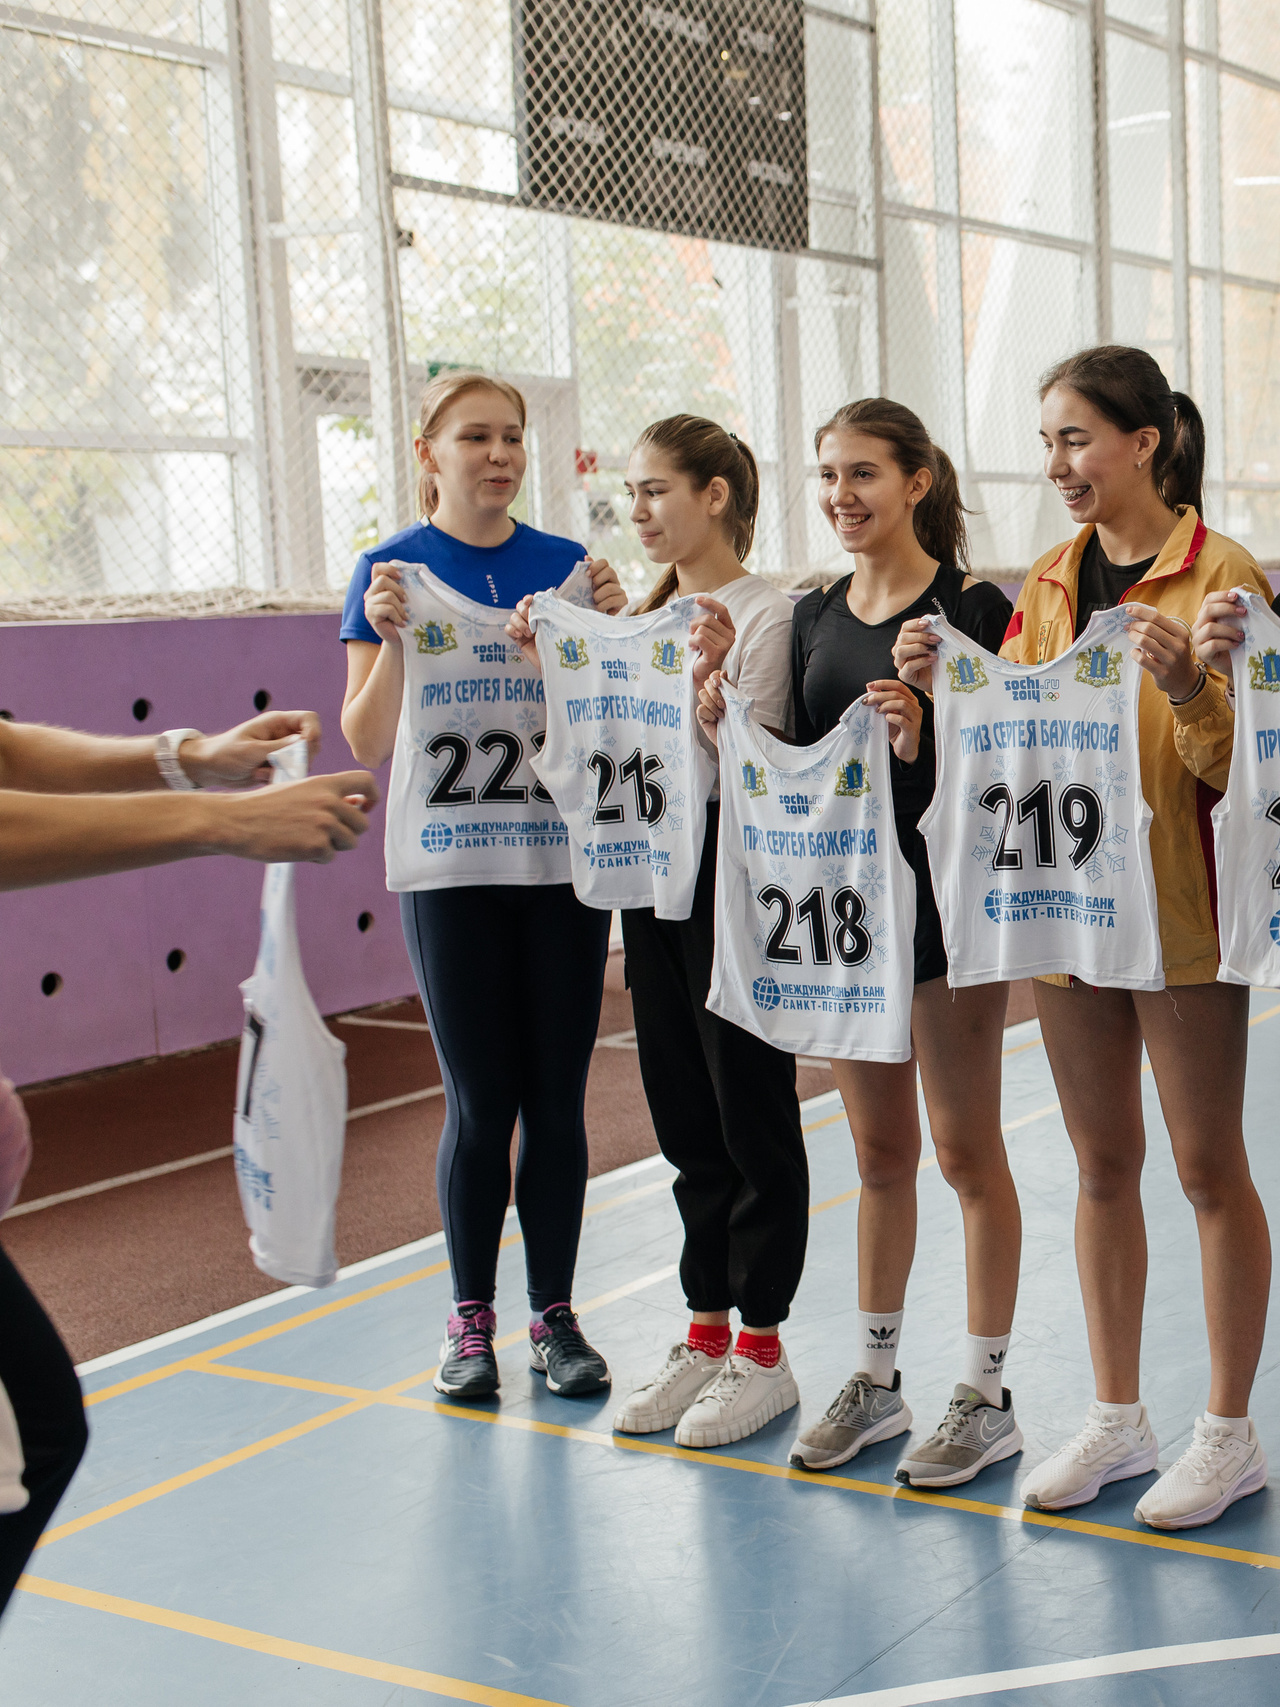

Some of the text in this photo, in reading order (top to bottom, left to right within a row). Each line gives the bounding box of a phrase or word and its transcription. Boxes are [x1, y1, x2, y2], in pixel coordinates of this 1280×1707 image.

[486, 574, 499, 604] KIPSTA
[931, 597, 947, 618] DOMYO
[601, 658, 641, 672] sochi.ru
[421, 677, 547, 710] ПРИЗ СЕРГЕЯ БАЖА
[1004, 676, 1060, 691] sochi.ru
[566, 697, 593, 726] ПРИЗ
[960, 719, 1119, 758] ПРИЗ СЕРГЕЯ БАЖАНОВА
[587, 747, 667, 828] 216
[779, 792, 824, 805] sochi.ru
[455, 819, 568, 834] МЕЖДУНАРОДНЫЙ БА
[978, 779, 1104, 872] 219
[456, 836, 570, 849] САНКТ-ПЕТЕРБУРГ
[596, 839, 671, 862] МЕЖДУНА АНК
[766, 830, 807, 859] СЕРГЕЯ
[1002, 889, 1115, 910] ЕЖДУНАРОДНЫЙ БАНК
[756, 883, 872, 967] 218
[781, 983, 885, 998] МЕЖДУНАРОДНЫЙ БАНК
[783, 998, 886, 1014] САНКТ-ПЕТЕРБУРГА
[866, 1342, 895, 1350] adidas
